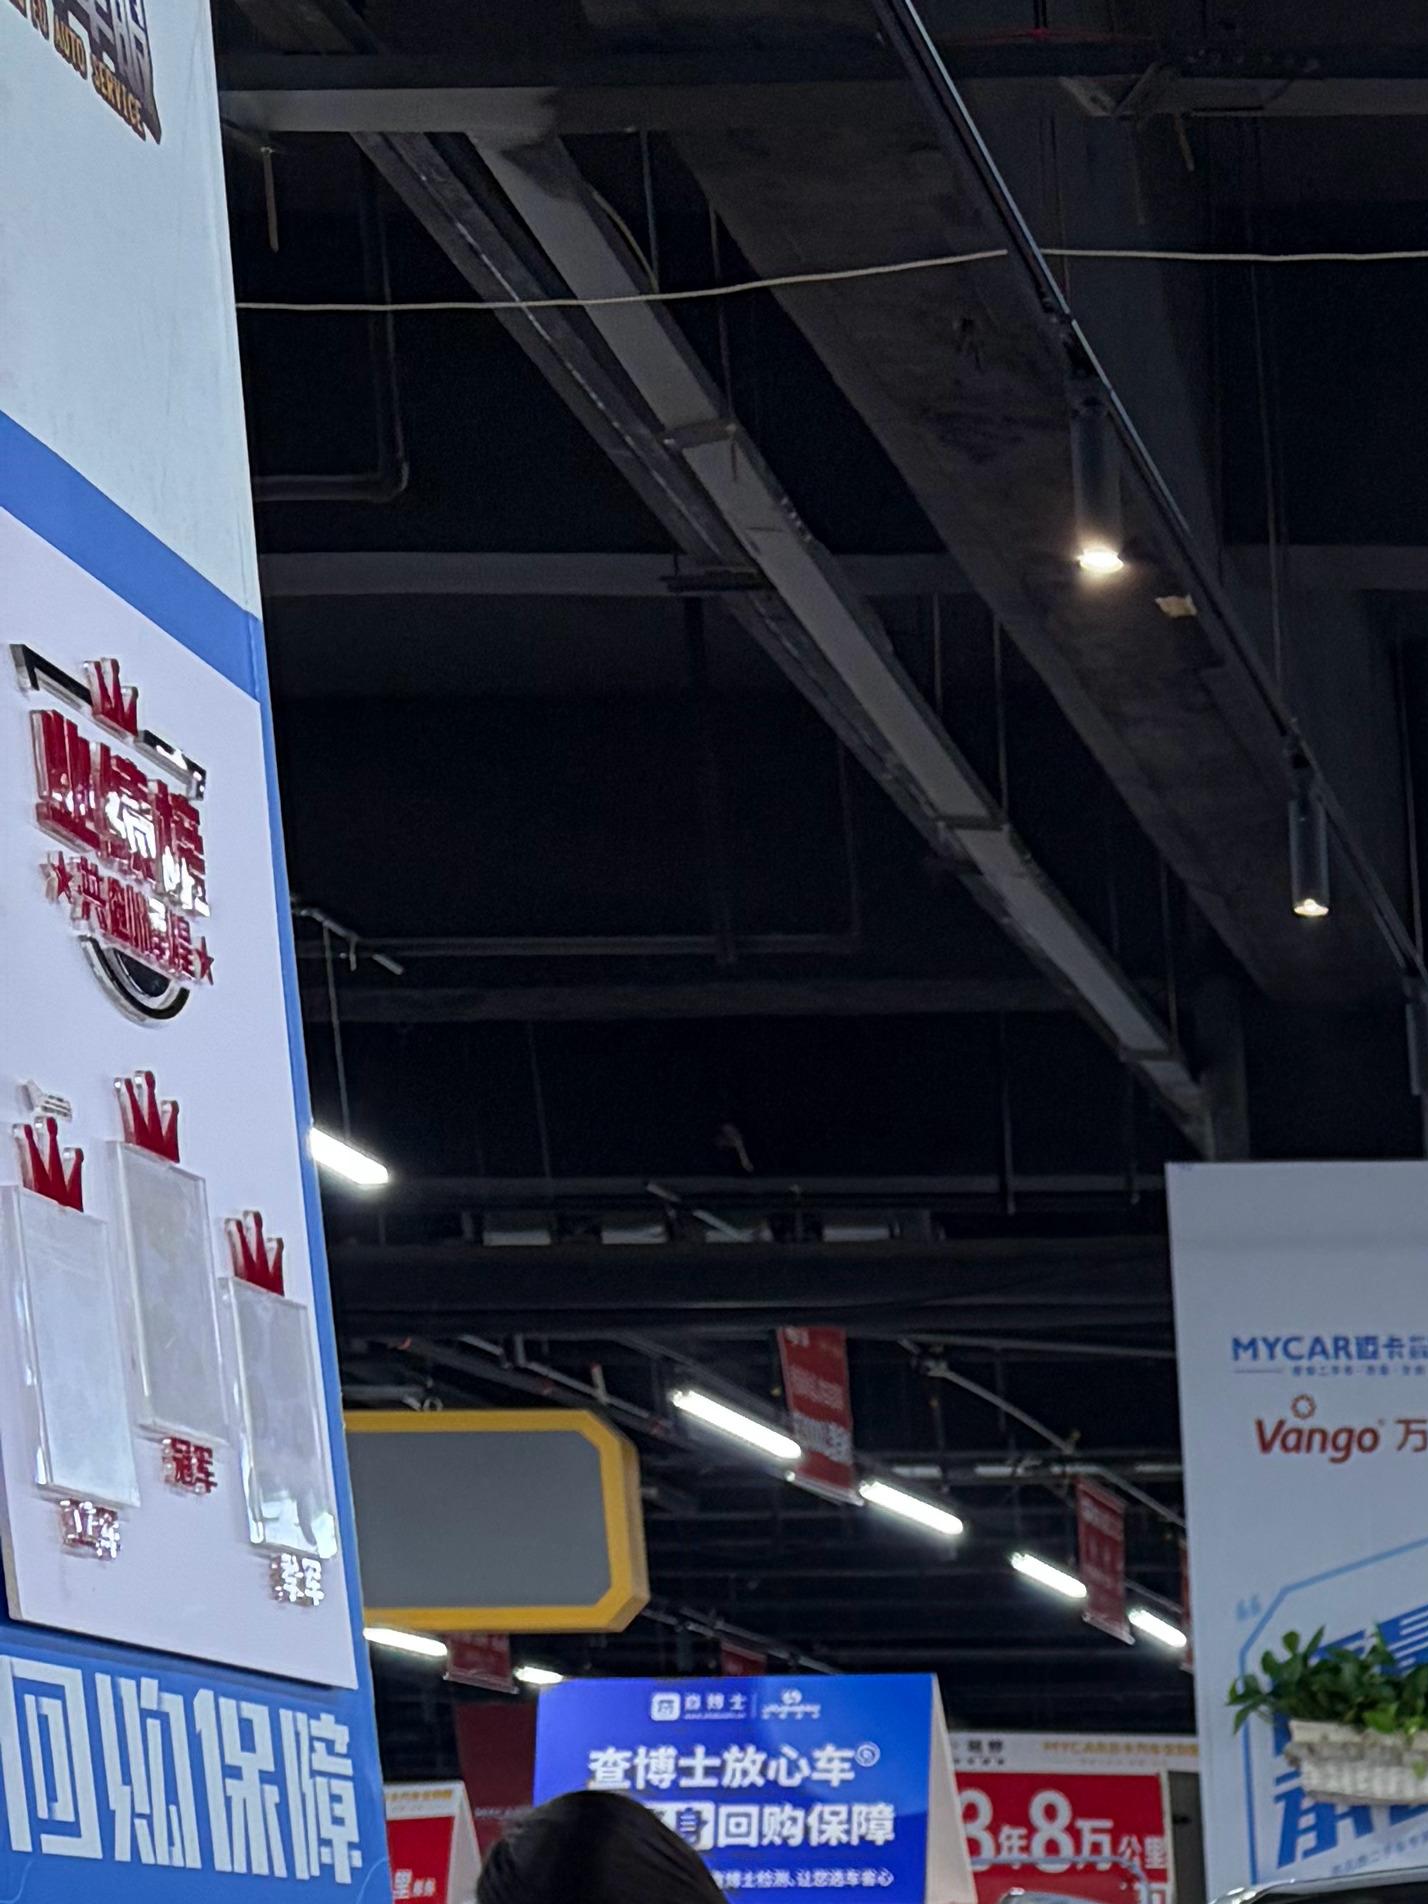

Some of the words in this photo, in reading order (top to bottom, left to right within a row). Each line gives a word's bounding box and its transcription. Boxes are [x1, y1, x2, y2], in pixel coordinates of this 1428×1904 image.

[53, 14, 87, 79] AUTO
[91, 55, 146, 140] SERVICE
[162, 1437, 219, 1495] 冠军
[1254, 1417, 1381, 1464] Vango
[0, 1655, 363, 1874] 回购保障
[587, 1743, 856, 1790] 查博士放心车
